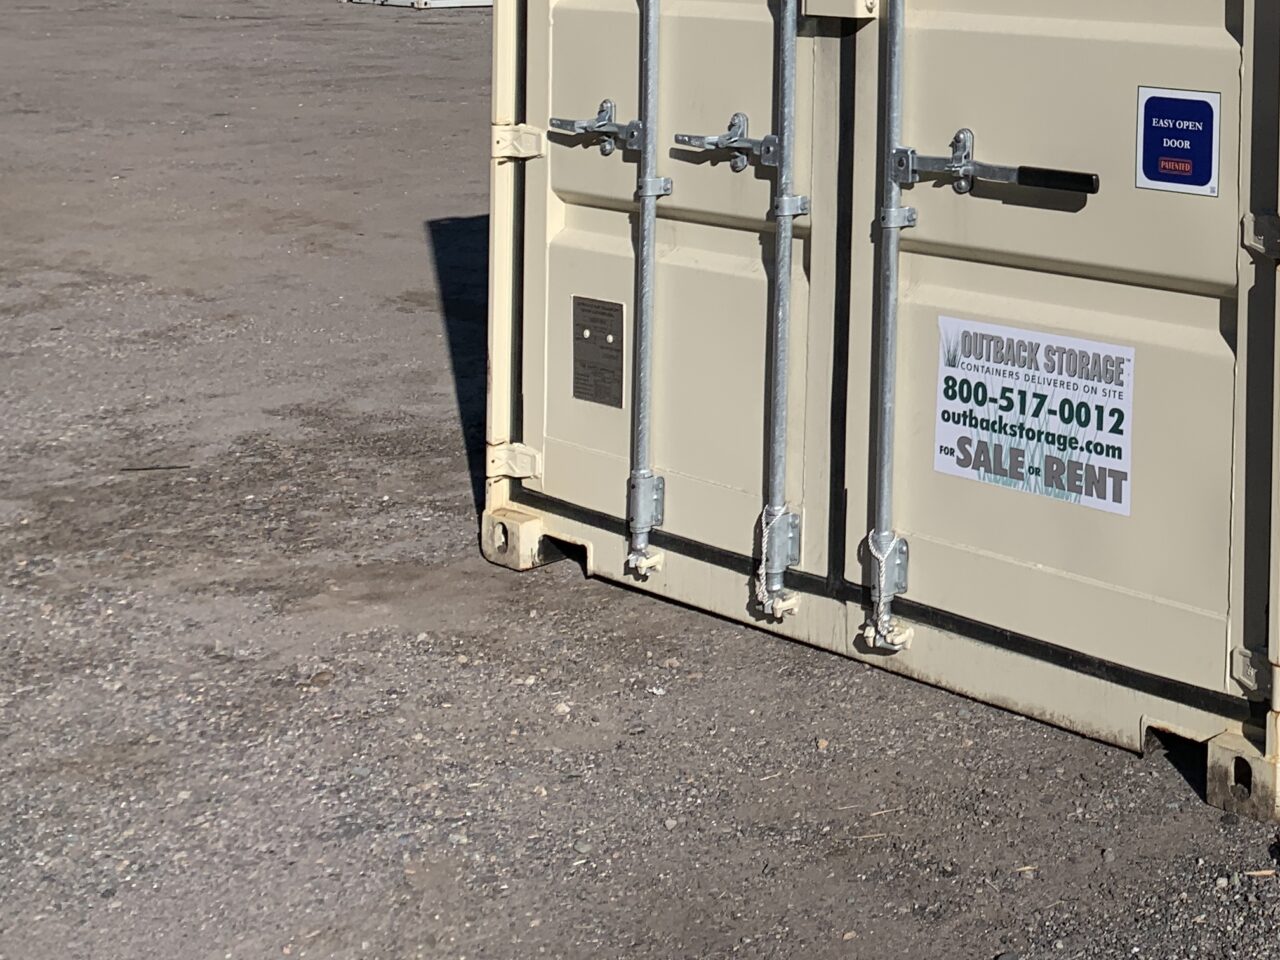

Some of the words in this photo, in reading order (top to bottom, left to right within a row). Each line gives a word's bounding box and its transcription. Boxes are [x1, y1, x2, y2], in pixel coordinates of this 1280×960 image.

[1152, 118, 1175, 129] EASY
[1175, 120, 1203, 131] OPEN
[1162, 138, 1191, 149] DOOR
[960, 362, 1020, 381] CONTAINERS
[1024, 373, 1079, 391] DELIVERED
[1083, 384, 1098, 395] ON
[1101, 389, 1124, 400] SITE
[961, 330, 1040, 371] OUTBACK
[1043, 344, 1125, 387] STORAGE
[943, 375, 1125, 435] 800-517-0012
[941, 409, 1122, 460] outbackstorage.com
[939, 446, 955, 457] FOR
[956, 435, 1025, 481] SALE
[1028, 466, 1041, 477] OR
[1044, 455, 1128, 504] RENT
